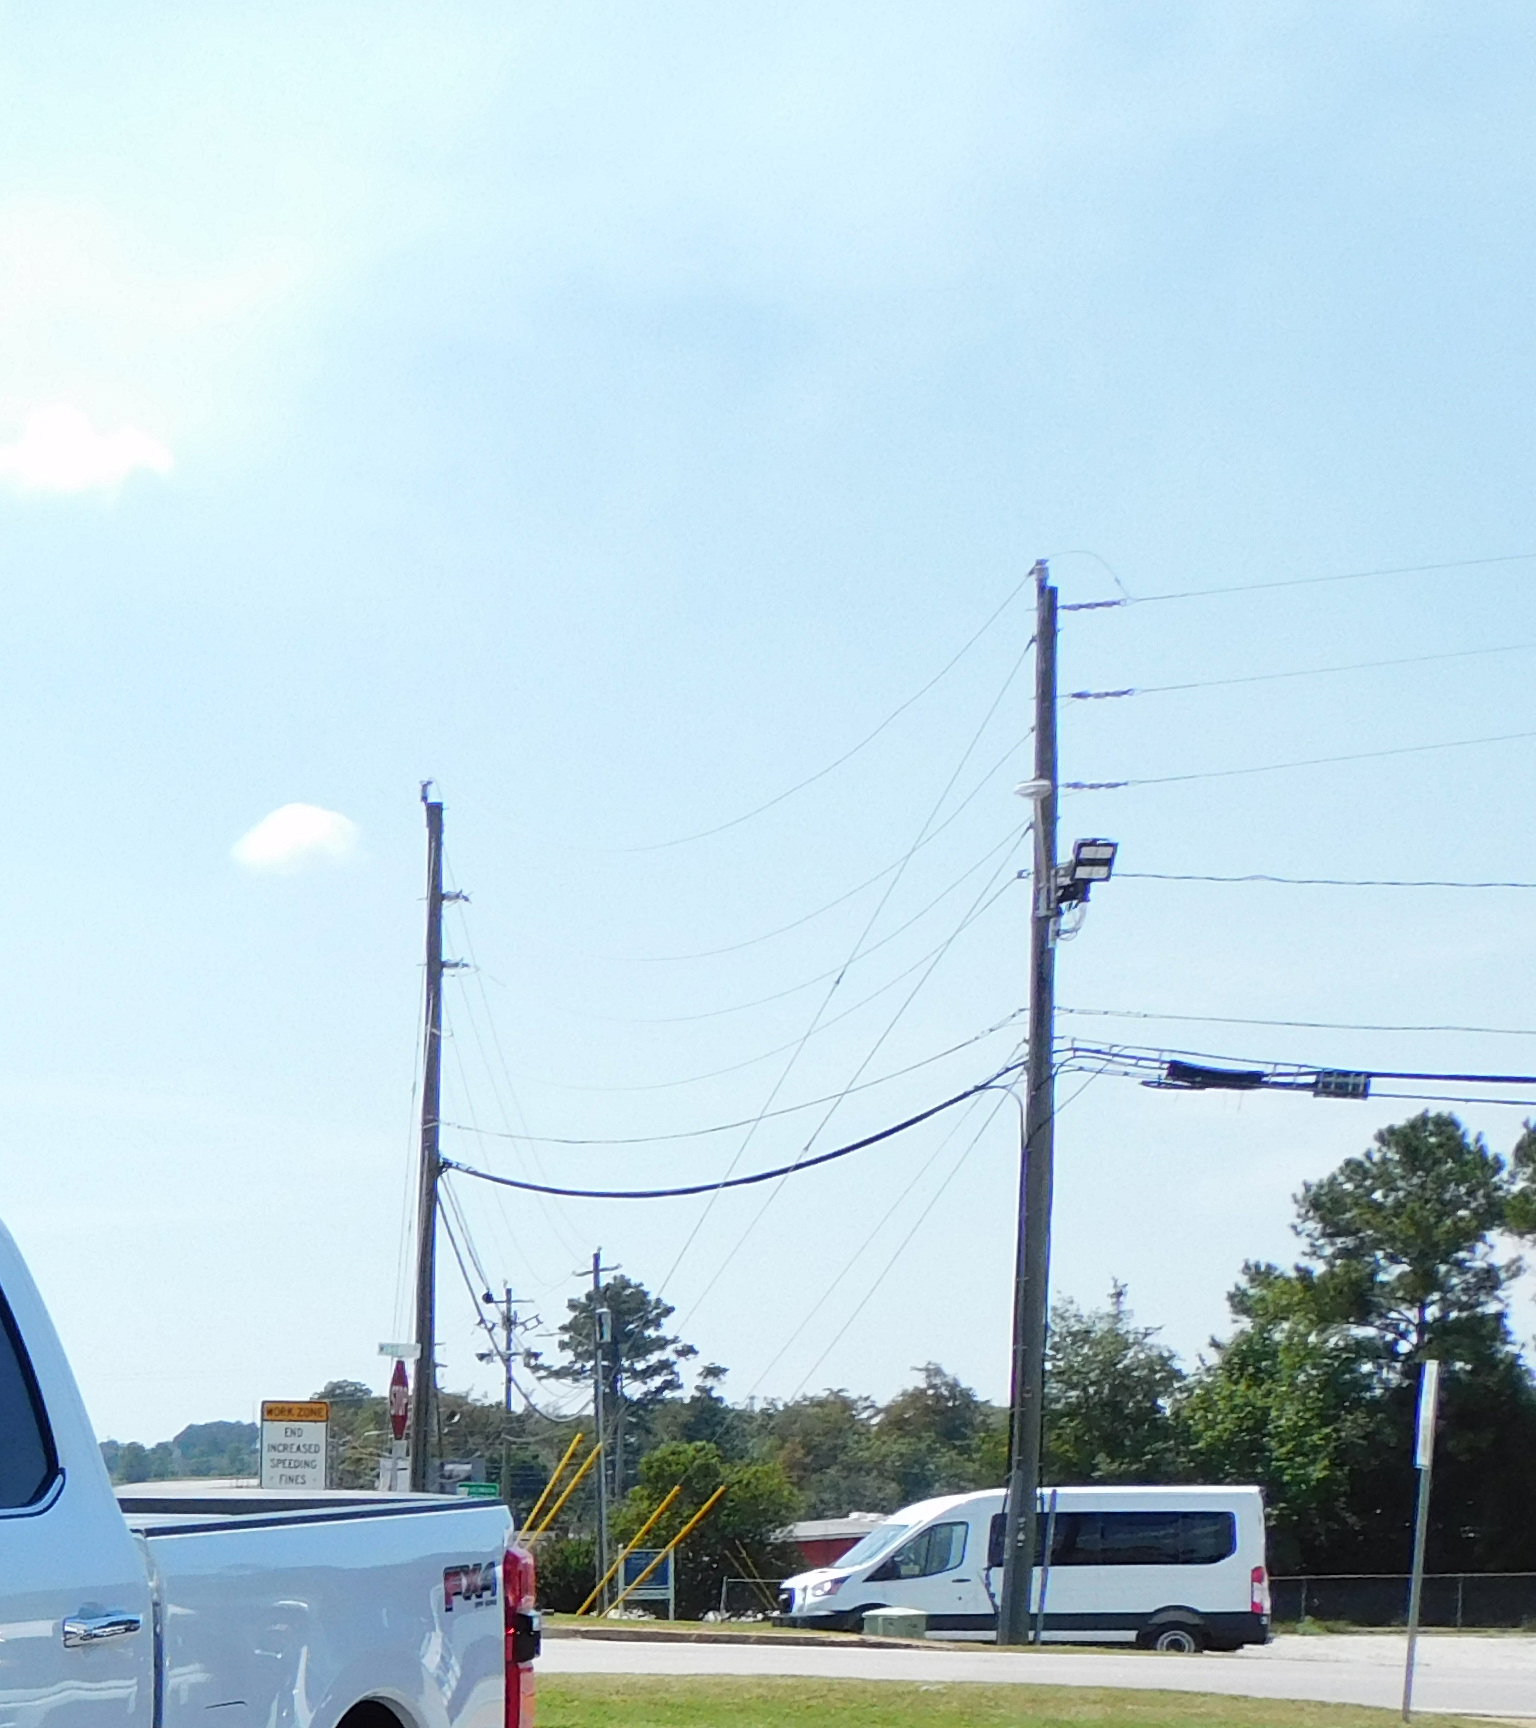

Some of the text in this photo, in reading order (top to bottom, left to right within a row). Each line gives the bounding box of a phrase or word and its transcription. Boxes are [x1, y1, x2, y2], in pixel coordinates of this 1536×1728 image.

[266, 1406, 325, 1418] WORK ZONE
[284, 1427, 304, 1438] END
[267, 1443, 320, 1454] INCREASED
[269, 1458, 317, 1469] SPEEDING
[279, 1474, 307, 1485] FINES
